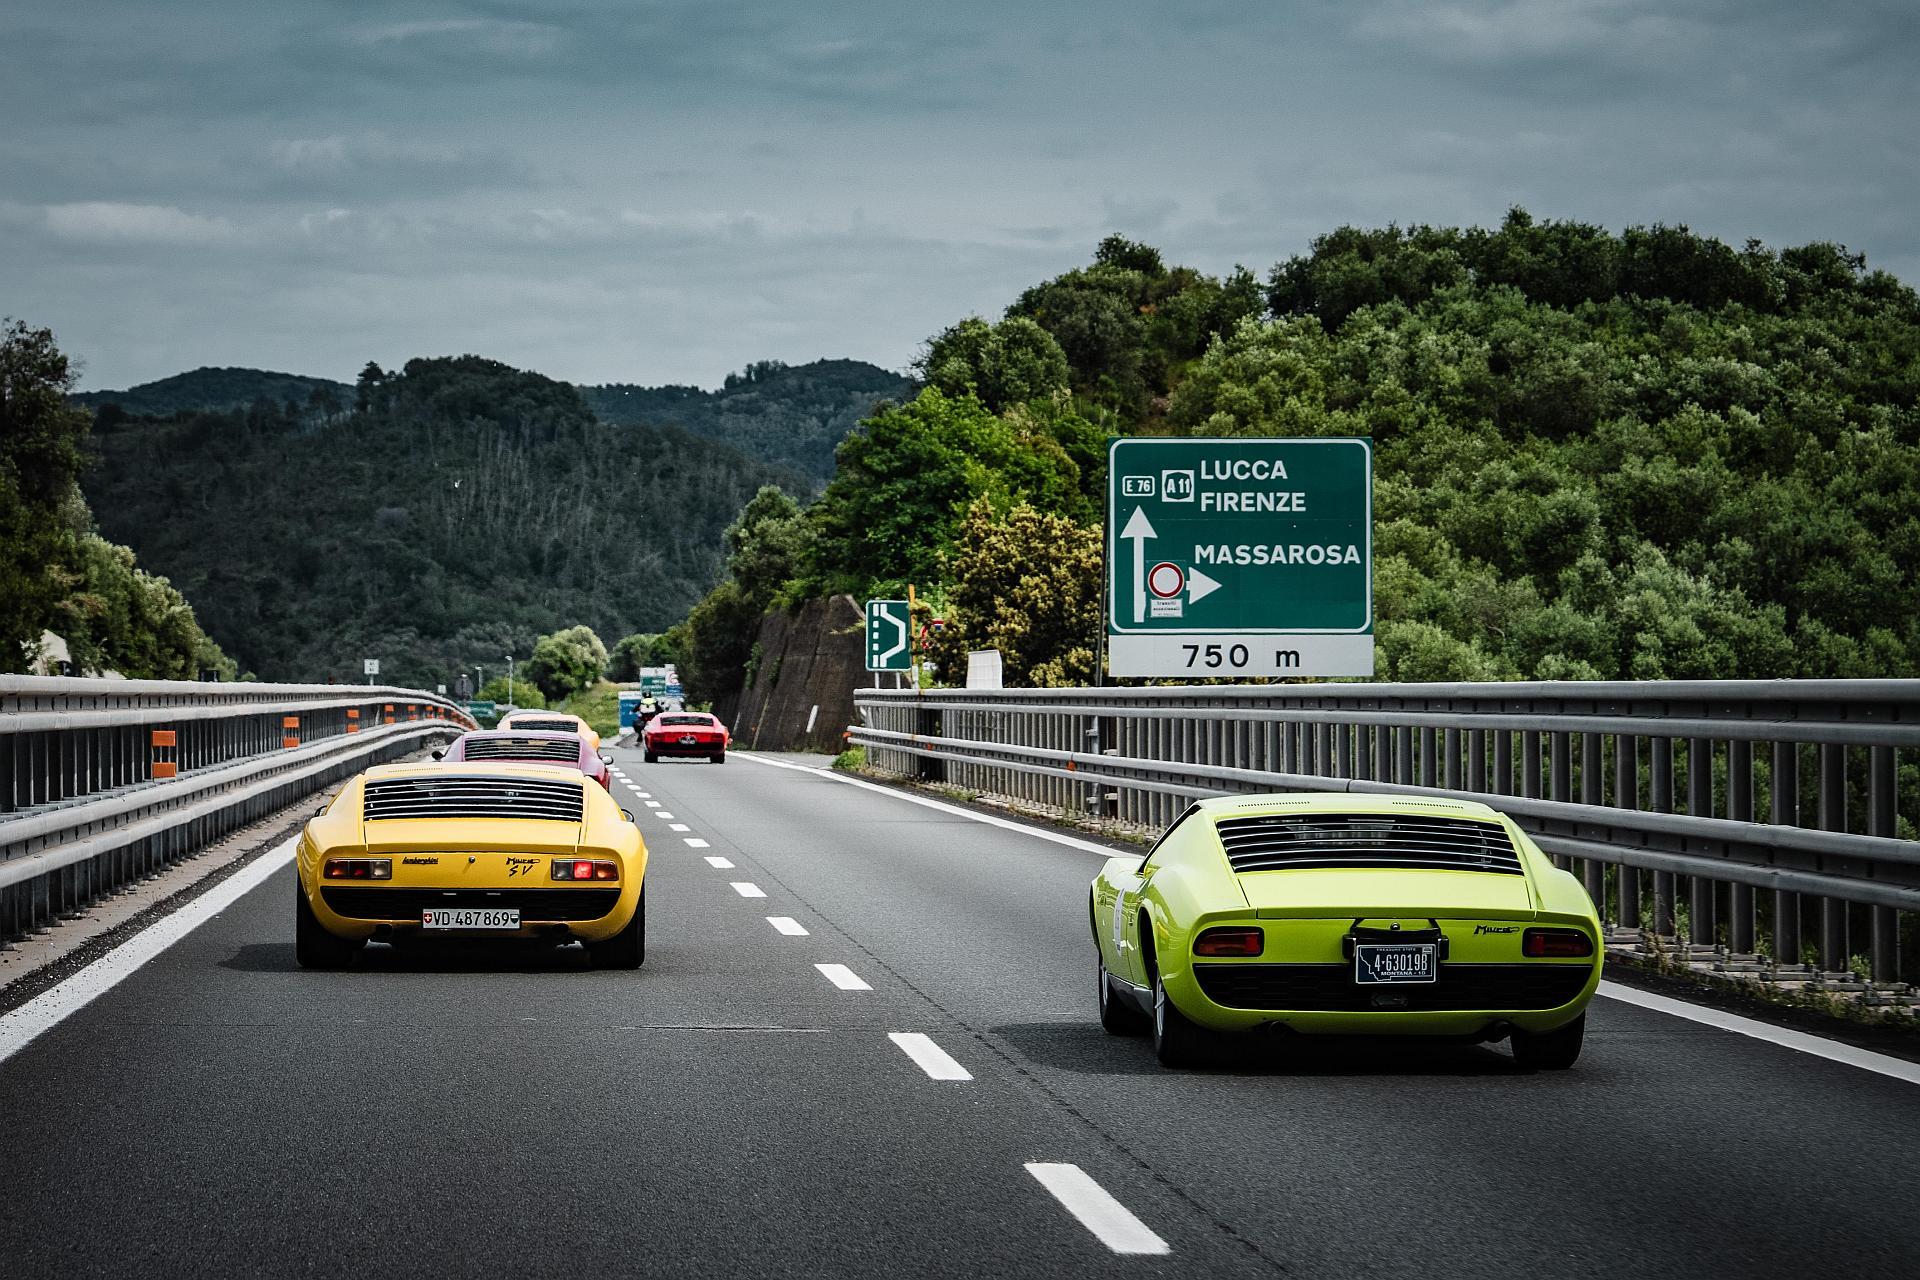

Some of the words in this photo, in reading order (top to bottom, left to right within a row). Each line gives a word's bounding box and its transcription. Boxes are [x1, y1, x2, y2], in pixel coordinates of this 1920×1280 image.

[1201, 460, 1288, 480] LUCCA
[1126, 480, 1133, 492] E
[1137, 480, 1151, 492] 76
[1166, 479, 1176, 493] A
[1178, 479, 1190, 493] 11
[1201, 492, 1306, 512] FIRENZE
[1194, 544, 1361, 565] MASSAROSA
[1182, 644, 1249, 668] 750
[1275, 650, 1300, 668] m
